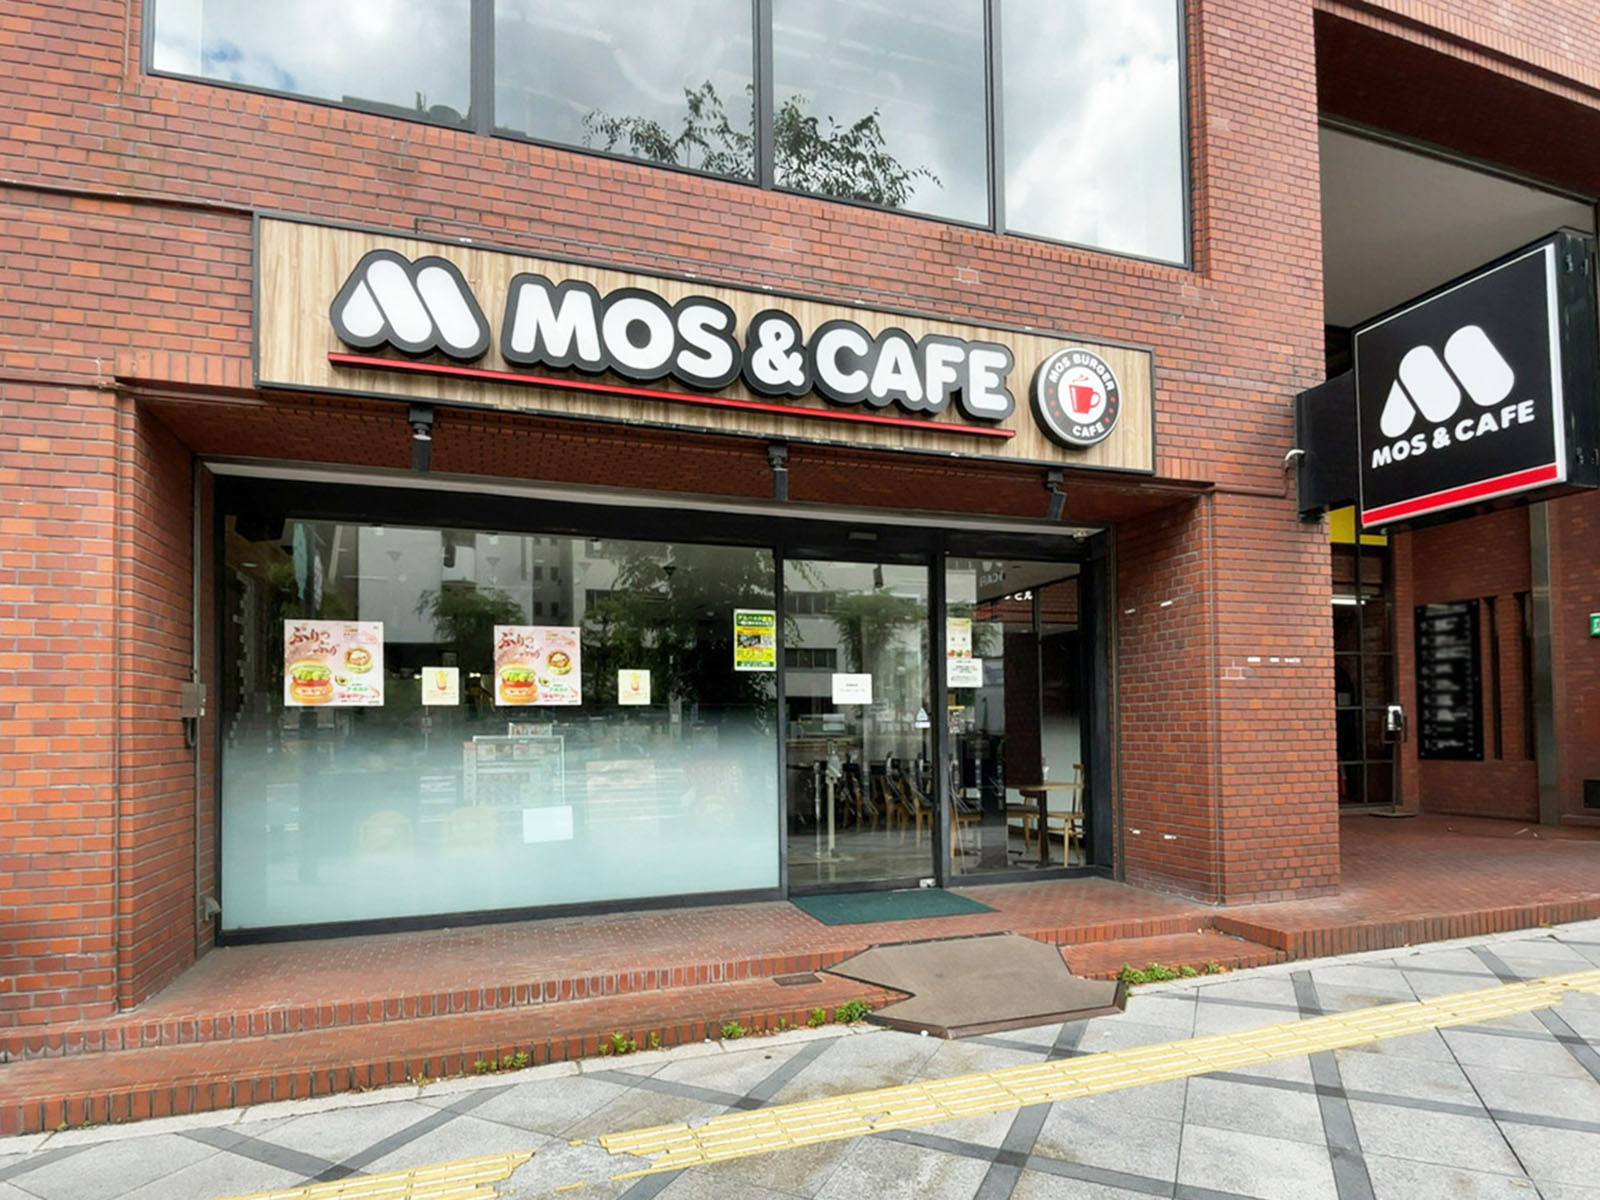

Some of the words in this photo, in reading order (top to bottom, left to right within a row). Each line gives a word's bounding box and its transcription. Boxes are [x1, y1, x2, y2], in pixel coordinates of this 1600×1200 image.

[511, 283, 733, 378] MOS
[751, 319, 805, 386] &
[816, 328, 1009, 411] CAFE
[1048, 357, 1071, 383] MOS
[1073, 353, 1115, 391] BURGER
[1072, 422, 1105, 437] CAFE
[1372, 434, 1427, 468] MOS
[1432, 427, 1451, 450] &
[1455, 400, 1535, 441] CAFE
